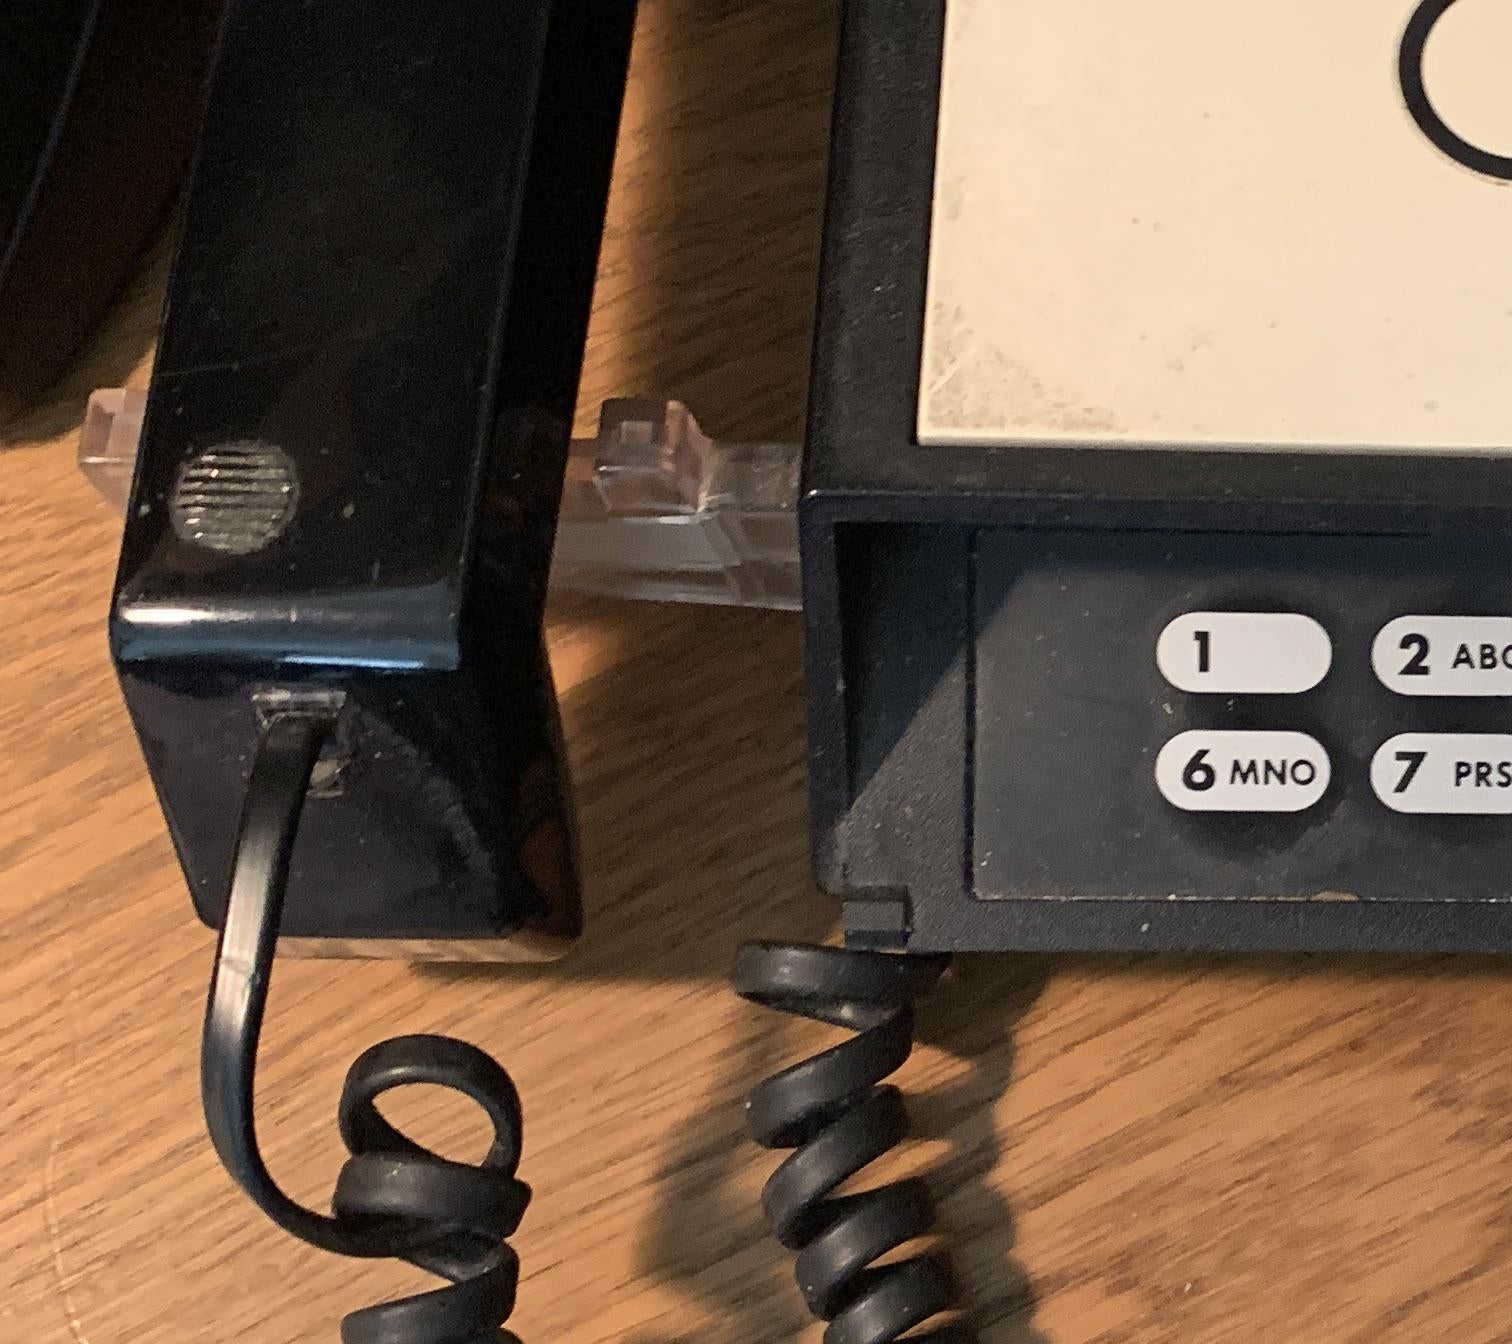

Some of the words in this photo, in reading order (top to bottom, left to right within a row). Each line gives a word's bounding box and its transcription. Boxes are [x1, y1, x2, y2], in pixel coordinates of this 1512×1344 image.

[1193, 630, 1211, 673] 1
[1397, 632, 1431, 676] 2
[1181, 748, 1217, 793] 6
[1229, 758, 1317, 786] MNO
[1393, 750, 1429, 794] 7
[1454, 760, 1512, 788] PRS
